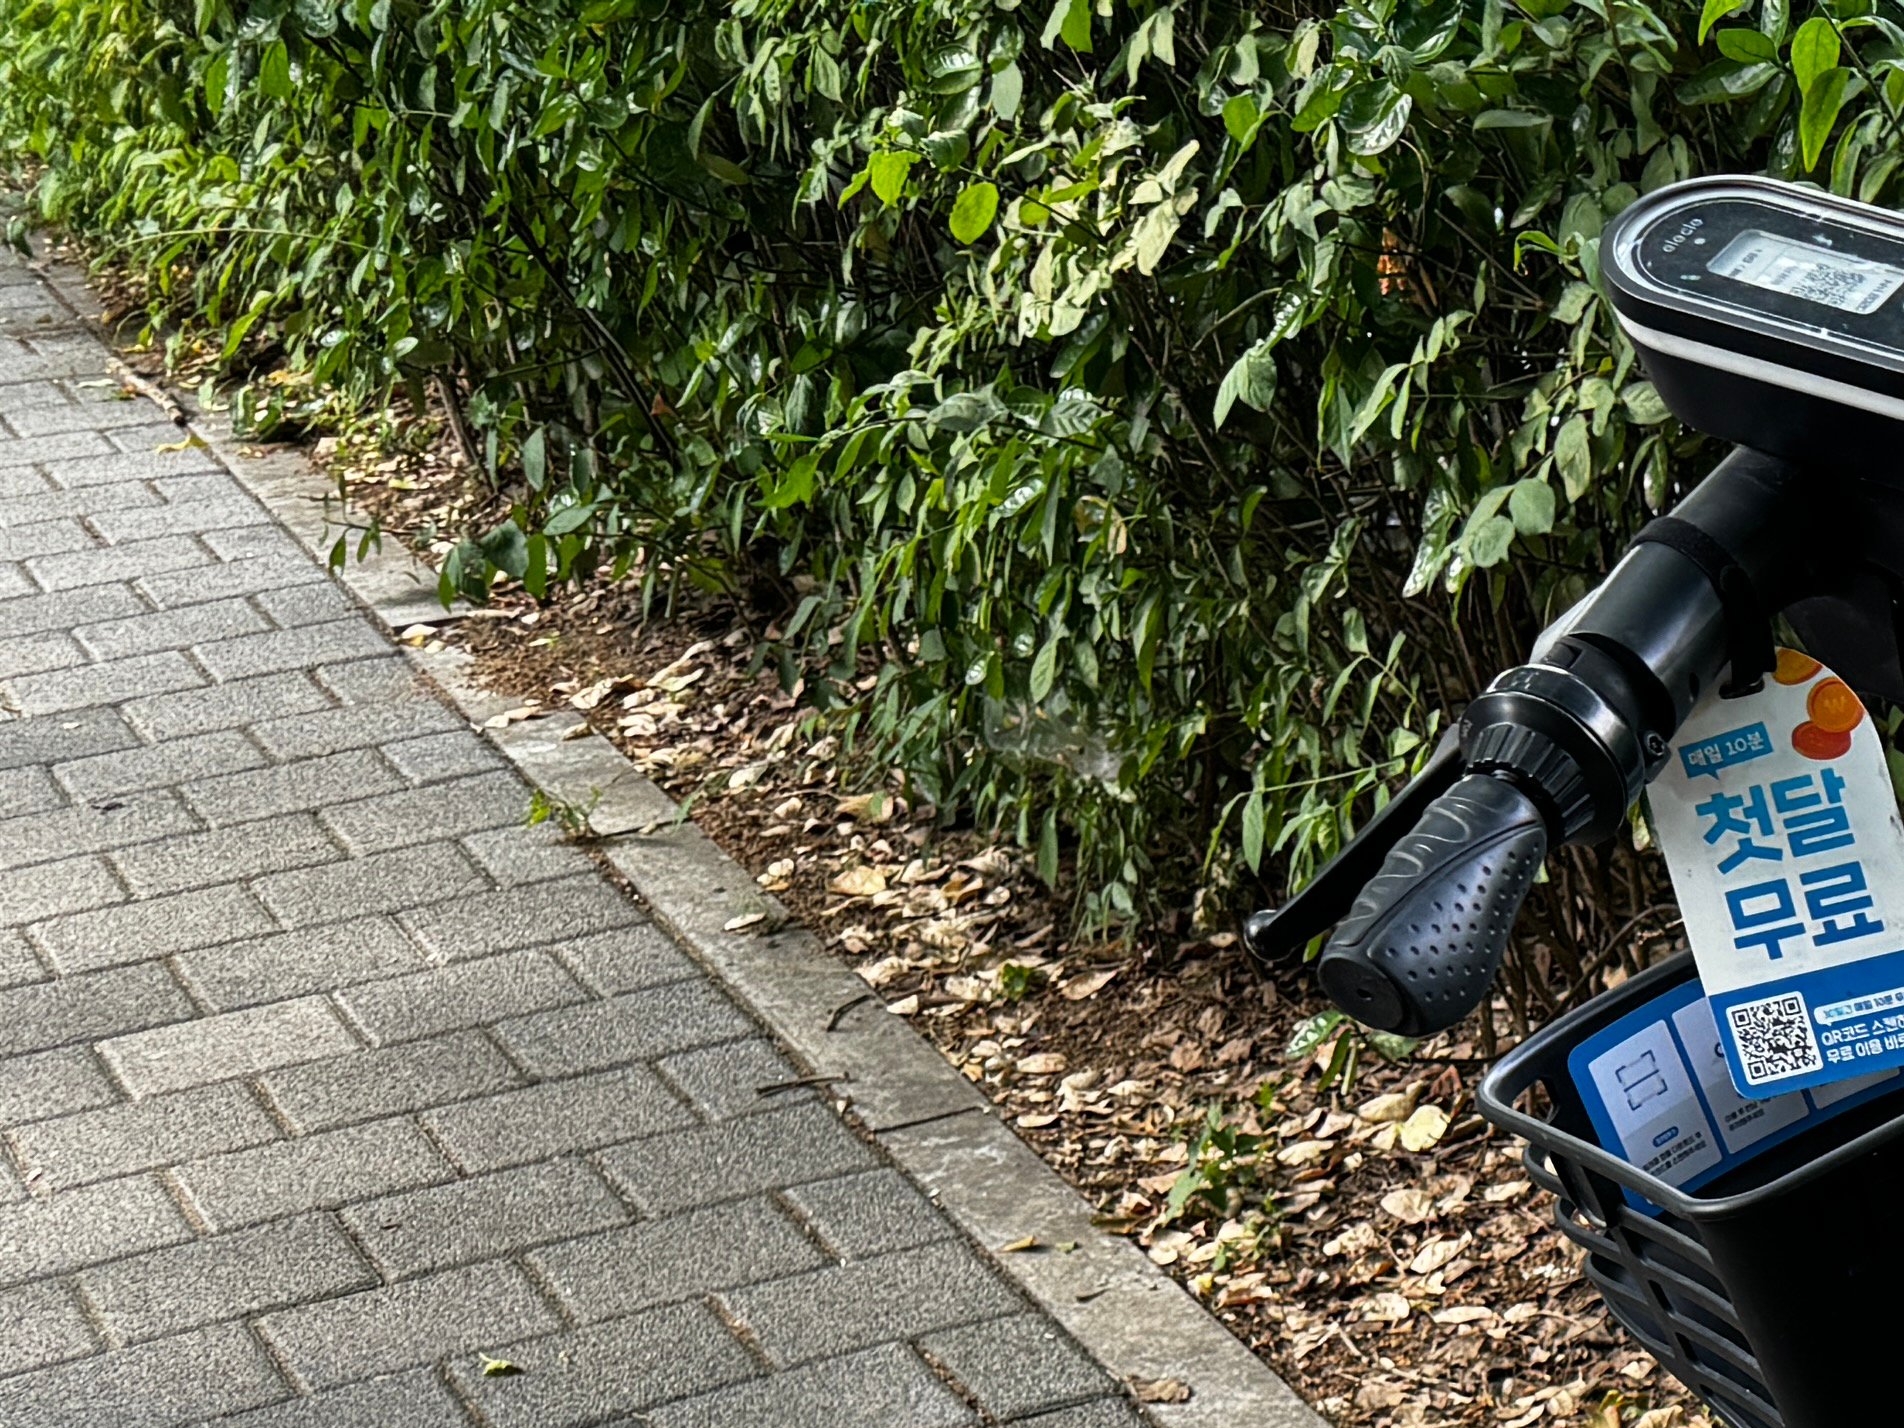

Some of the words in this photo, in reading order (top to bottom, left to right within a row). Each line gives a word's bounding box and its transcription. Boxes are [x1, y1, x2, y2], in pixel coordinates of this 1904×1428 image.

[1725, 731, 1765, 756] 10분
[1695, 768, 1856, 875] 첫달
[1726, 860, 1885, 960] 무료
[1821, 1023, 1870, 1046] QR코드
[1826, 1045, 1855, 1064] 무료
[1856, 1038, 1884, 1056] 이용
